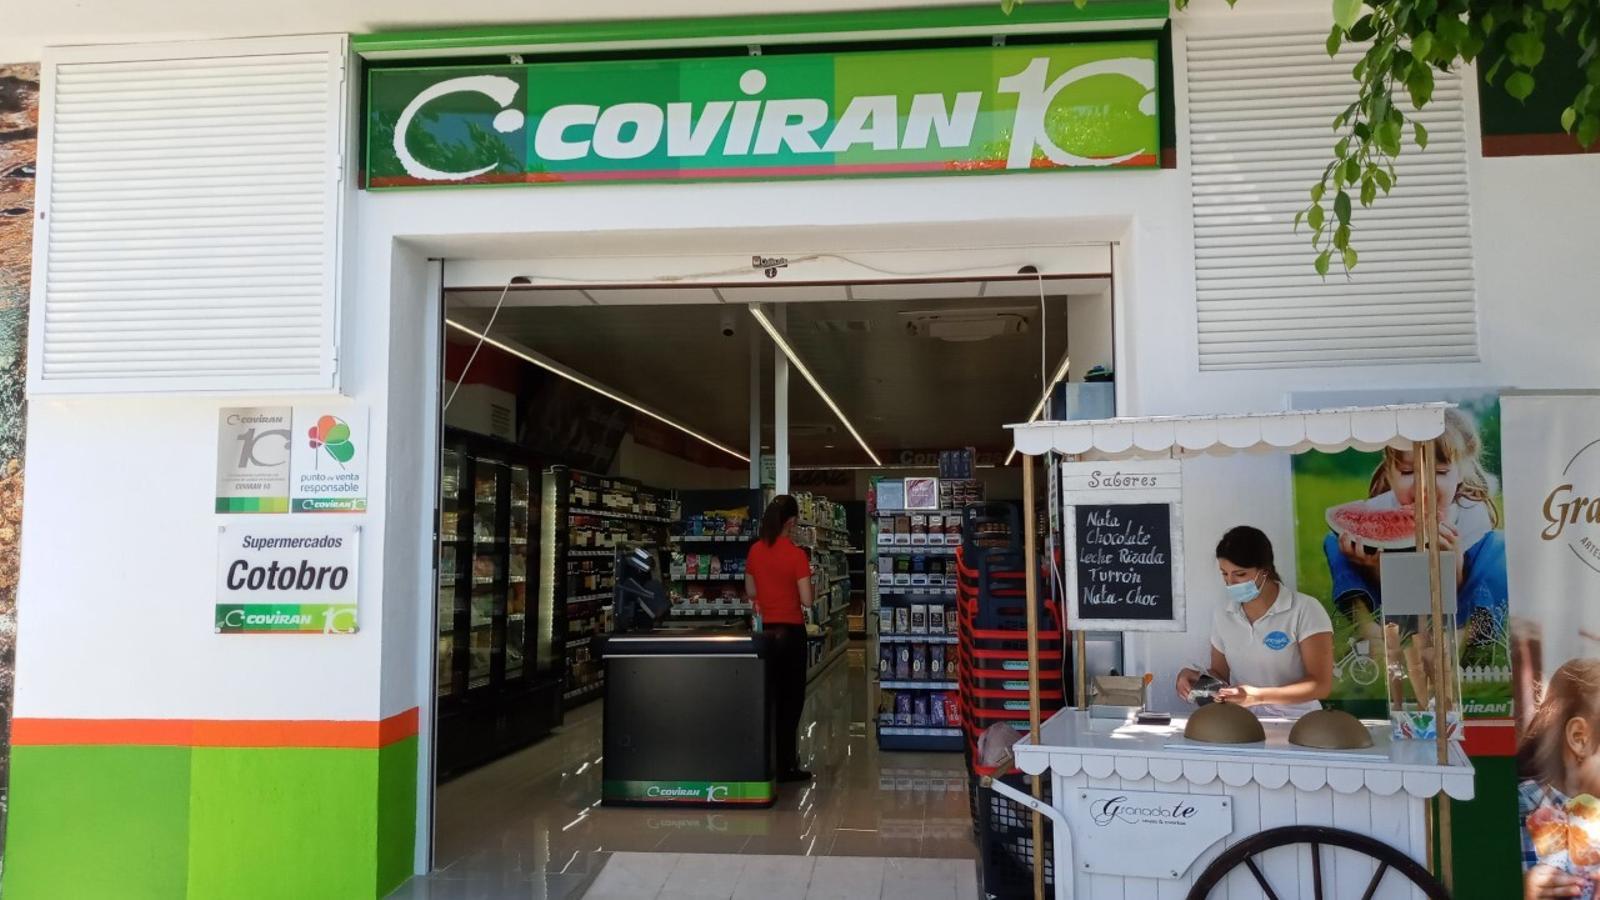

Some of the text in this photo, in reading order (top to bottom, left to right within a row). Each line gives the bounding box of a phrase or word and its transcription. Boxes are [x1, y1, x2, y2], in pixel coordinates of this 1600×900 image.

[300, 472, 326, 482] punto
[335, 472, 360, 481] venta
[1087, 470, 1158, 488] Sabores
[300, 482, 359, 494] responsable
[1086, 509, 1120, 528] Nata
[1086, 520, 1151, 546] Chocolate
[242, 535, 343, 551] Supermercados
[226, 559, 349, 591] Cotobro
